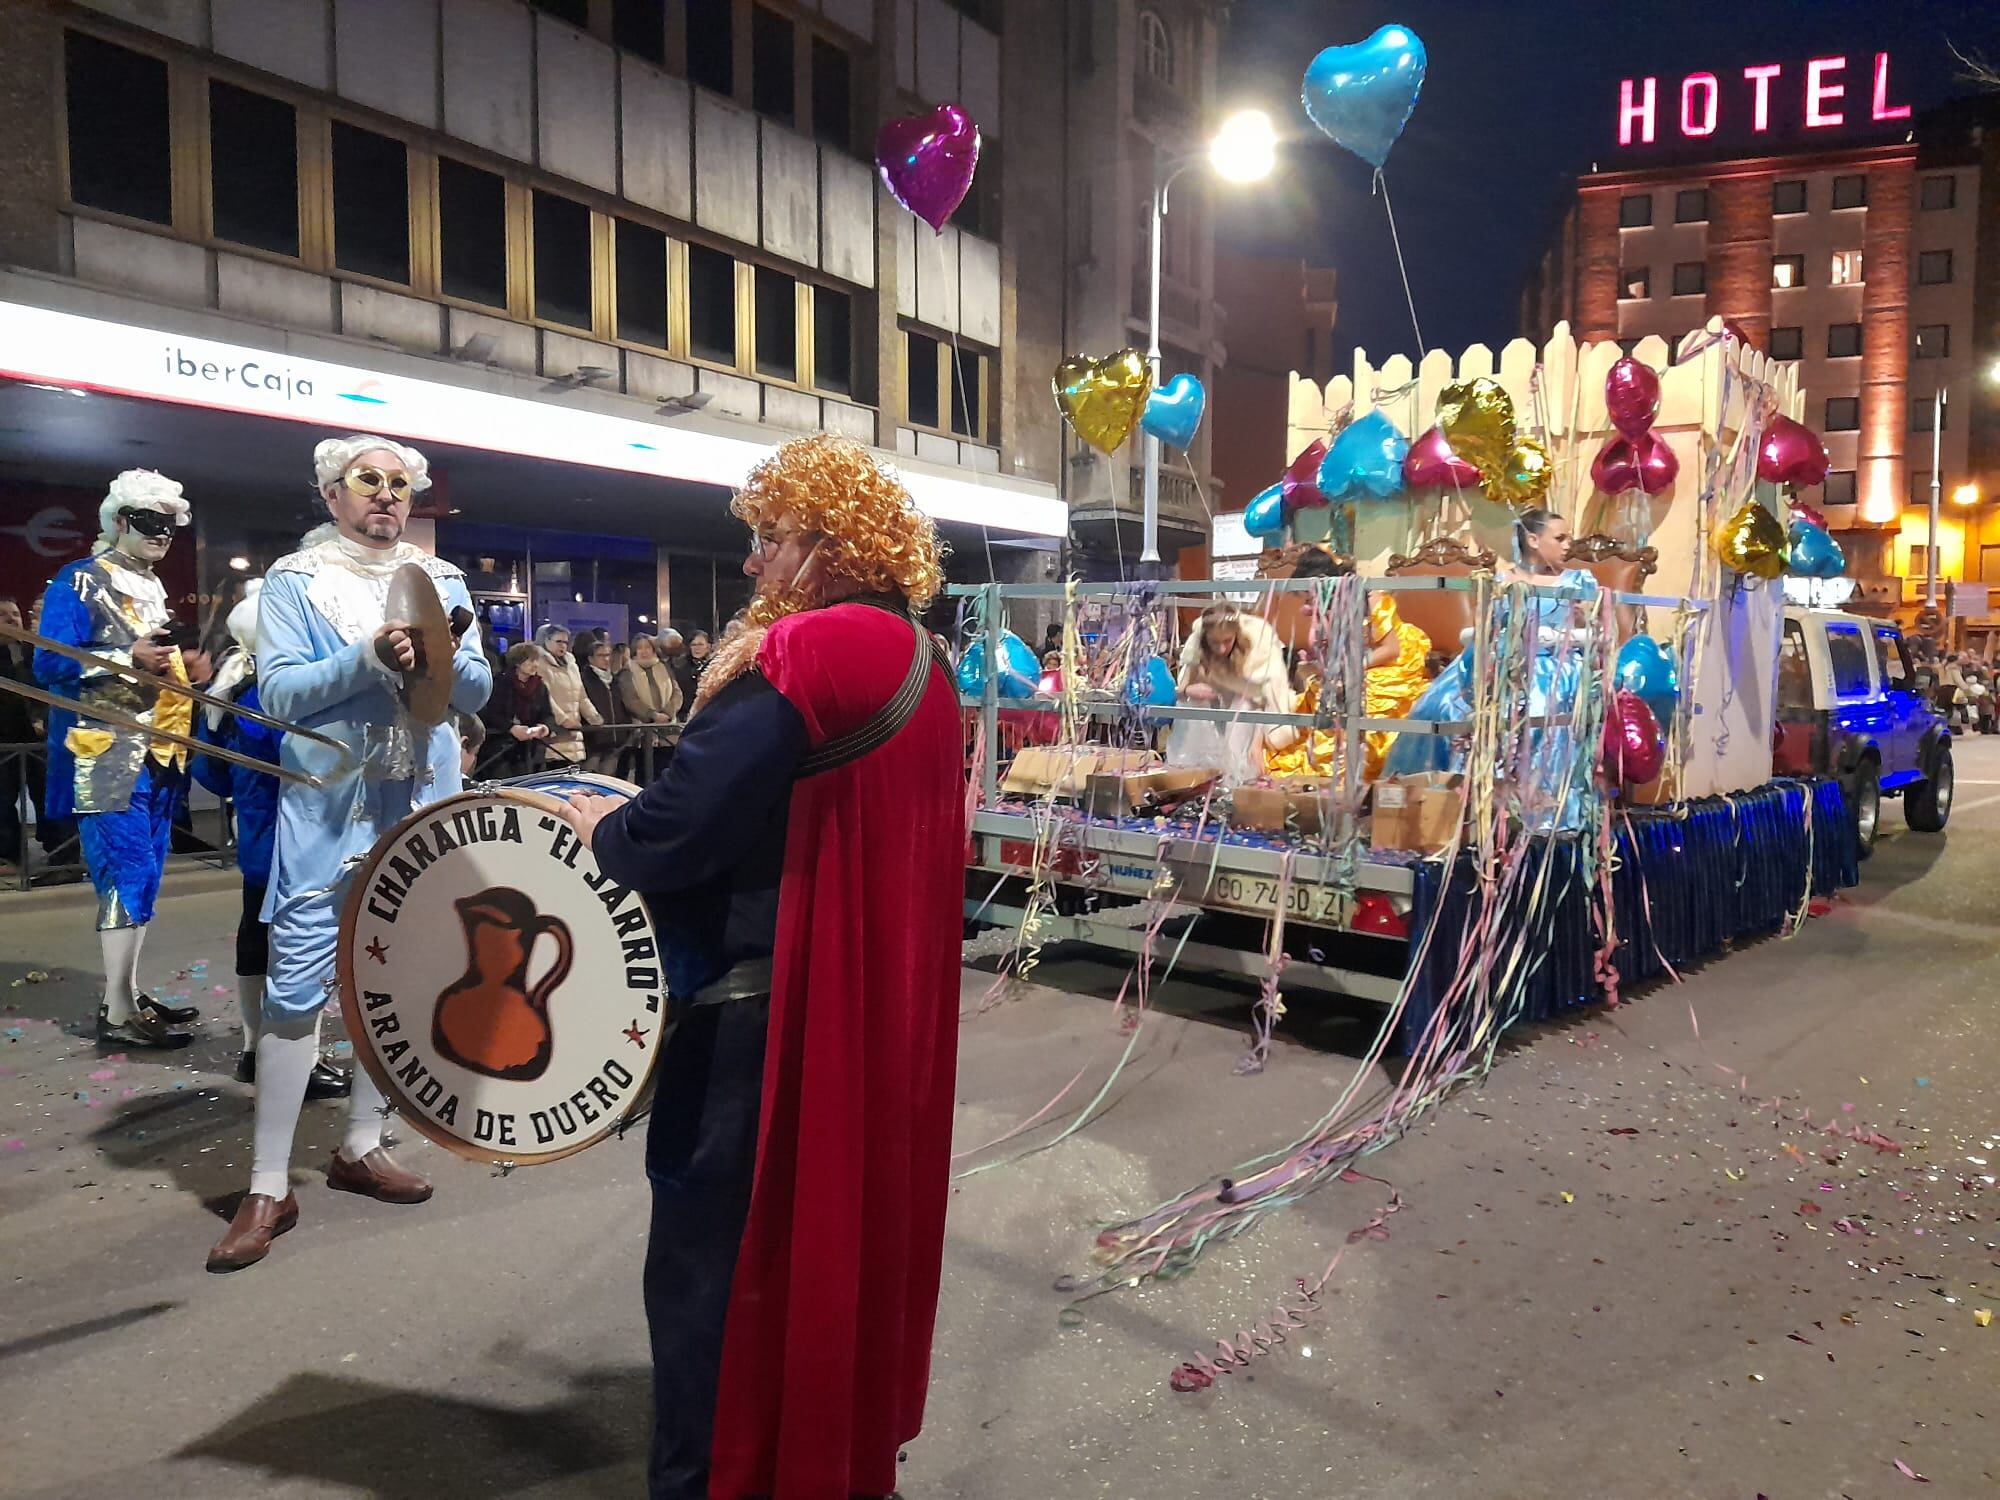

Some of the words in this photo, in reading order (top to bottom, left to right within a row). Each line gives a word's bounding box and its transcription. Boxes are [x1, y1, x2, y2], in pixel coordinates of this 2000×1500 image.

[1618, 51, 1912, 146] HOTEL
[165, 347, 313, 400] iberCaja
[367, 806, 522, 924] CHARANGA
[363, 990, 458, 1128] ARANDA
[474, 1109, 517, 1146] DE
[529, 1058, 634, 1144] DUERO
